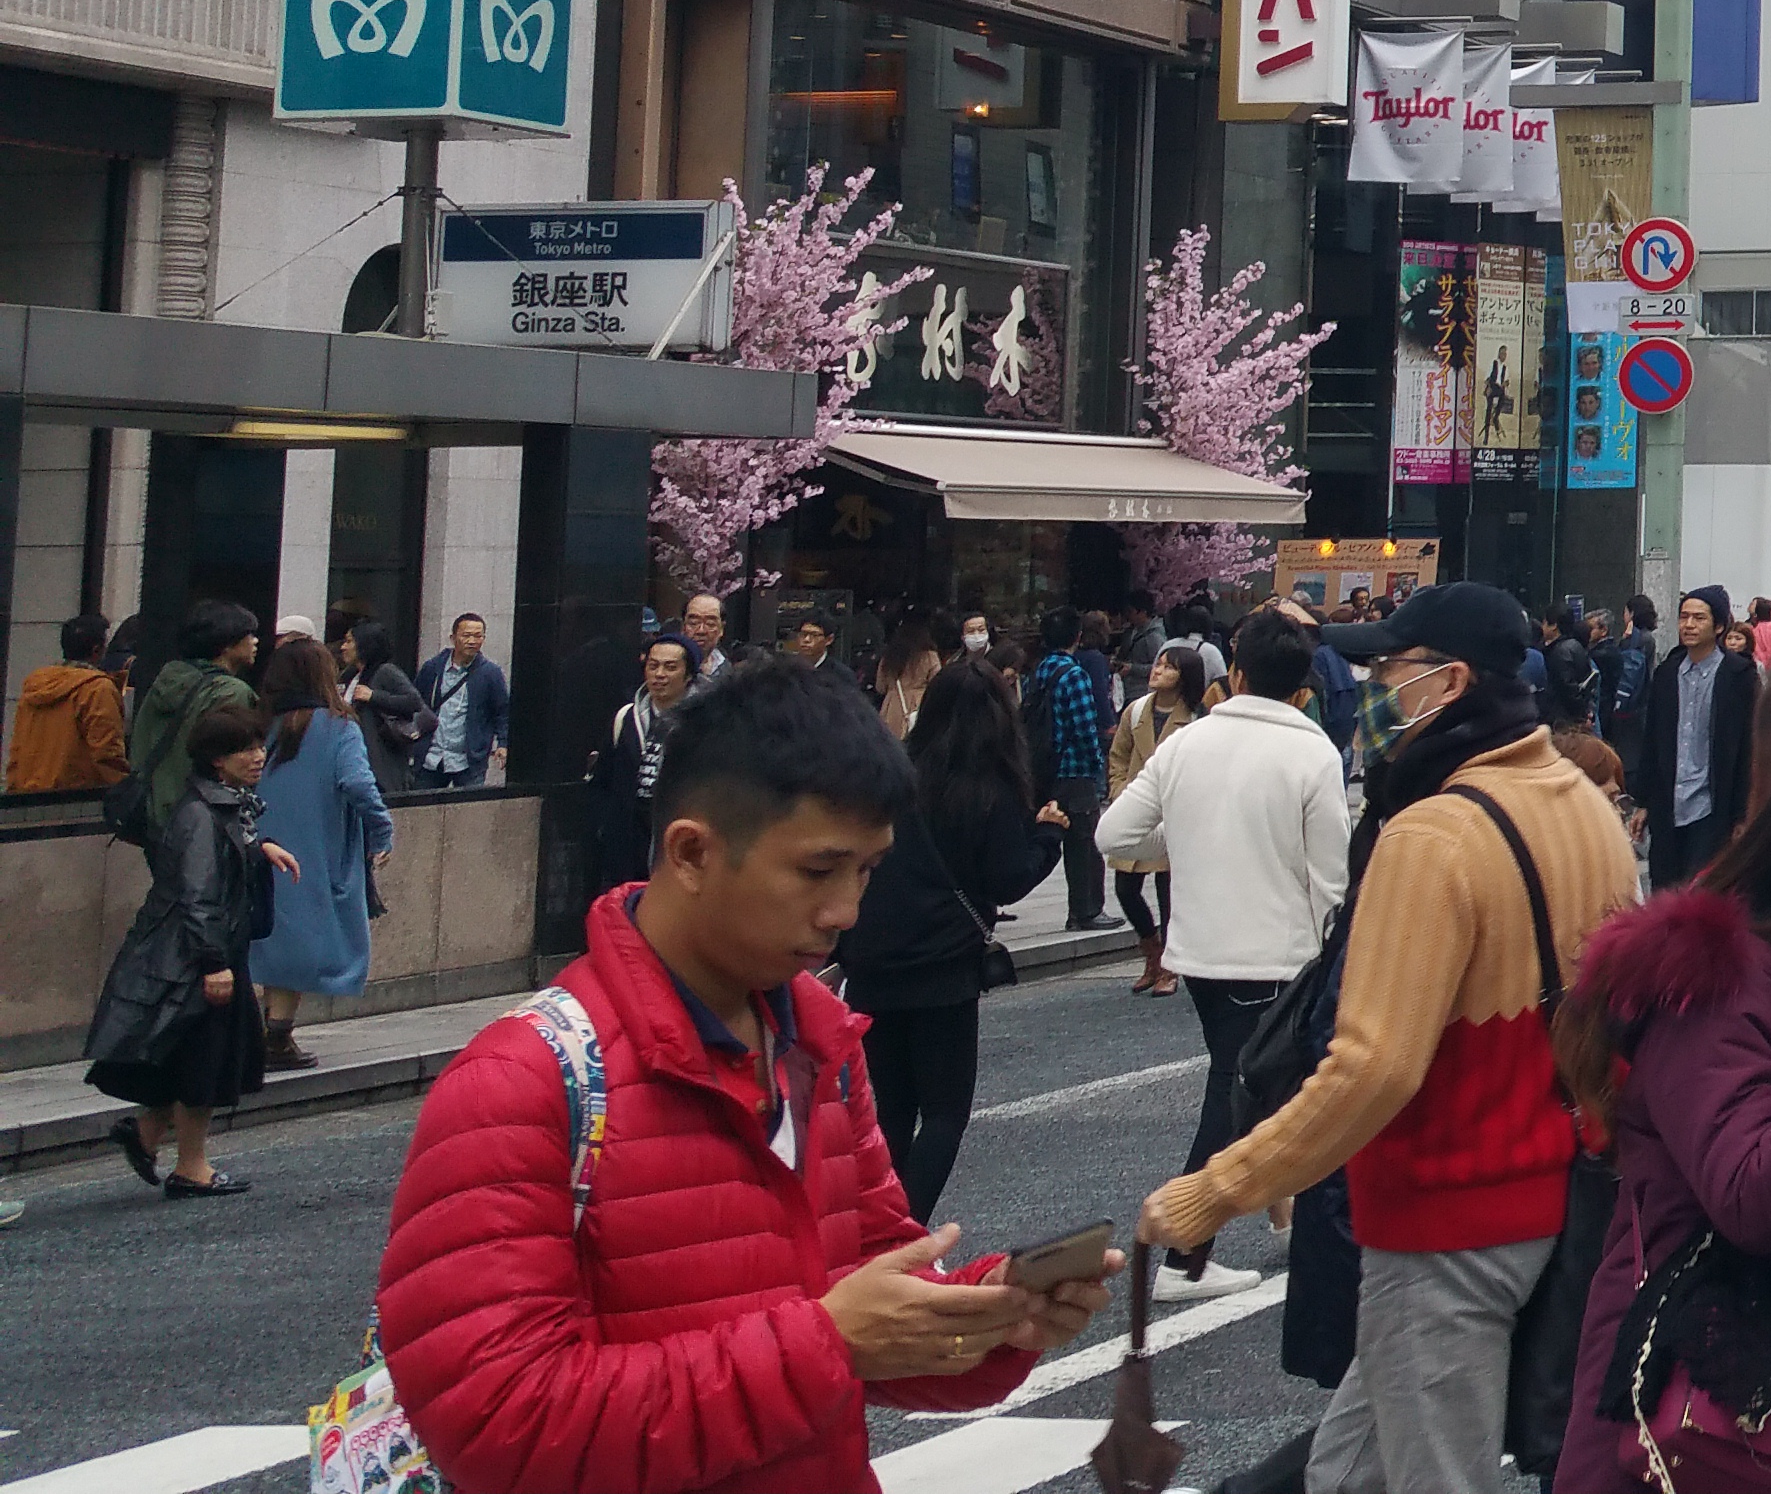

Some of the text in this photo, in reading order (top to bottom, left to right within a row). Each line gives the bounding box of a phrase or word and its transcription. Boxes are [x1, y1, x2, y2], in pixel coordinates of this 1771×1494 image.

[1362, 87, 1457, 129] Taylor
[528, 220, 619, 240] 東京メトロ
[1571, 222, 1634, 238] TOKY
[533, 241, 612, 257] Tokyo Metro
[510, 271, 629, 309] 銀座駅
[1479, 296, 1522, 312] アンドレア
[511, 310, 627, 334] Ginza Sta.
[1478, 312, 1521, 327] ボチェッリ
[1434, 272, 1457, 446] サラ・ブライトマン
